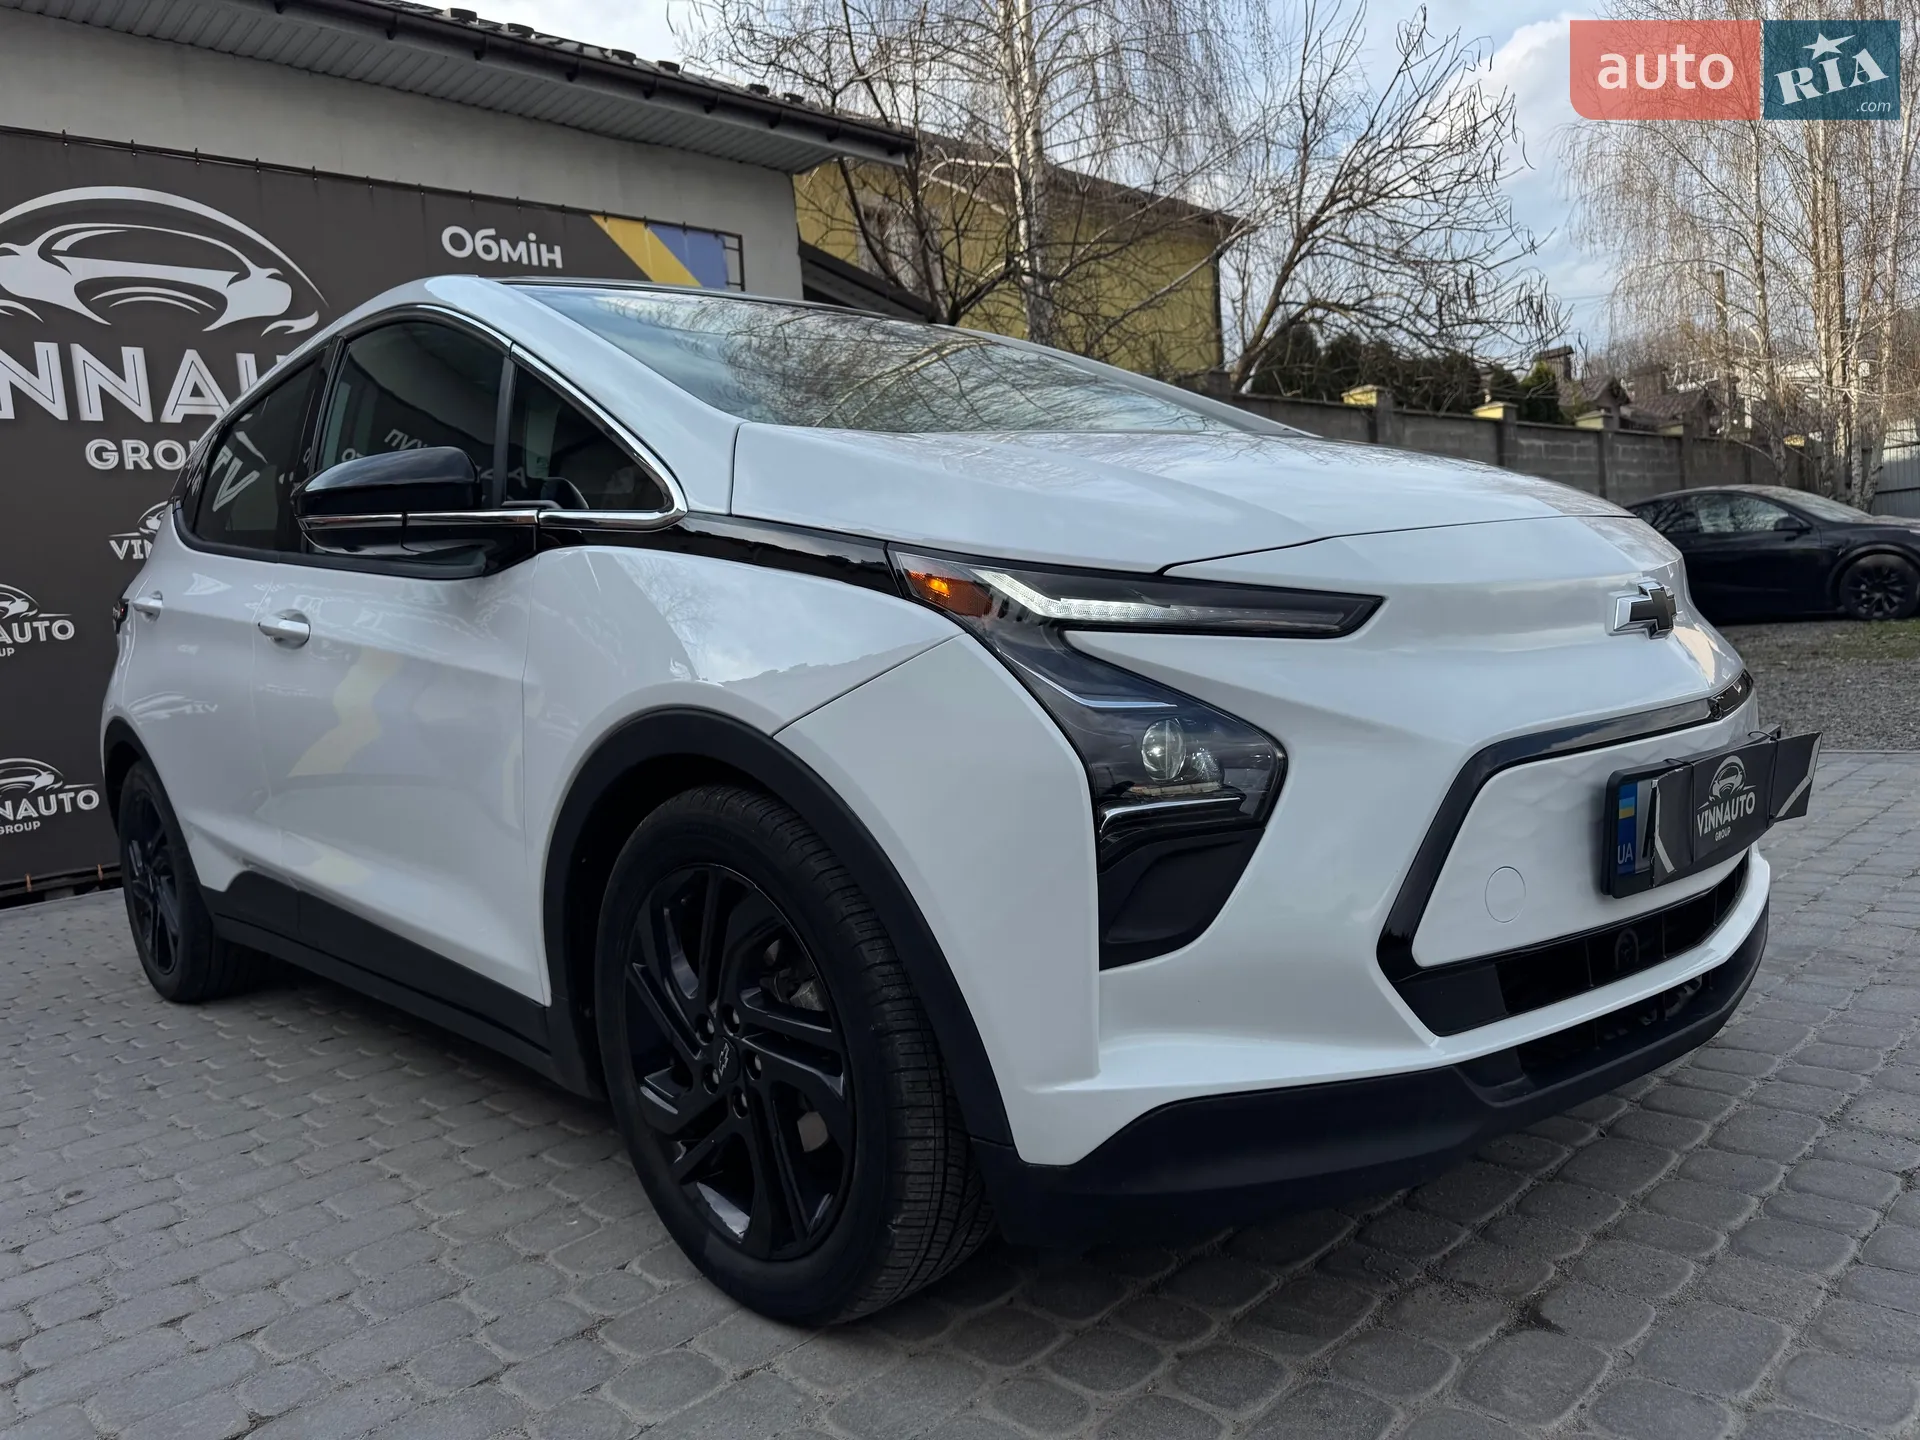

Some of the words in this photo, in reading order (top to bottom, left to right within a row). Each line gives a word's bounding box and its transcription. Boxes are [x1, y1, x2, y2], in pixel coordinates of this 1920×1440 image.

[441, 225, 563, 269] Обмін
[85, 438, 200, 471] GRO
[1696, 791, 1756, 838] VINNAUTO
[1715, 826, 1732, 842] GROUP
[1617, 843, 1634, 865] UA
